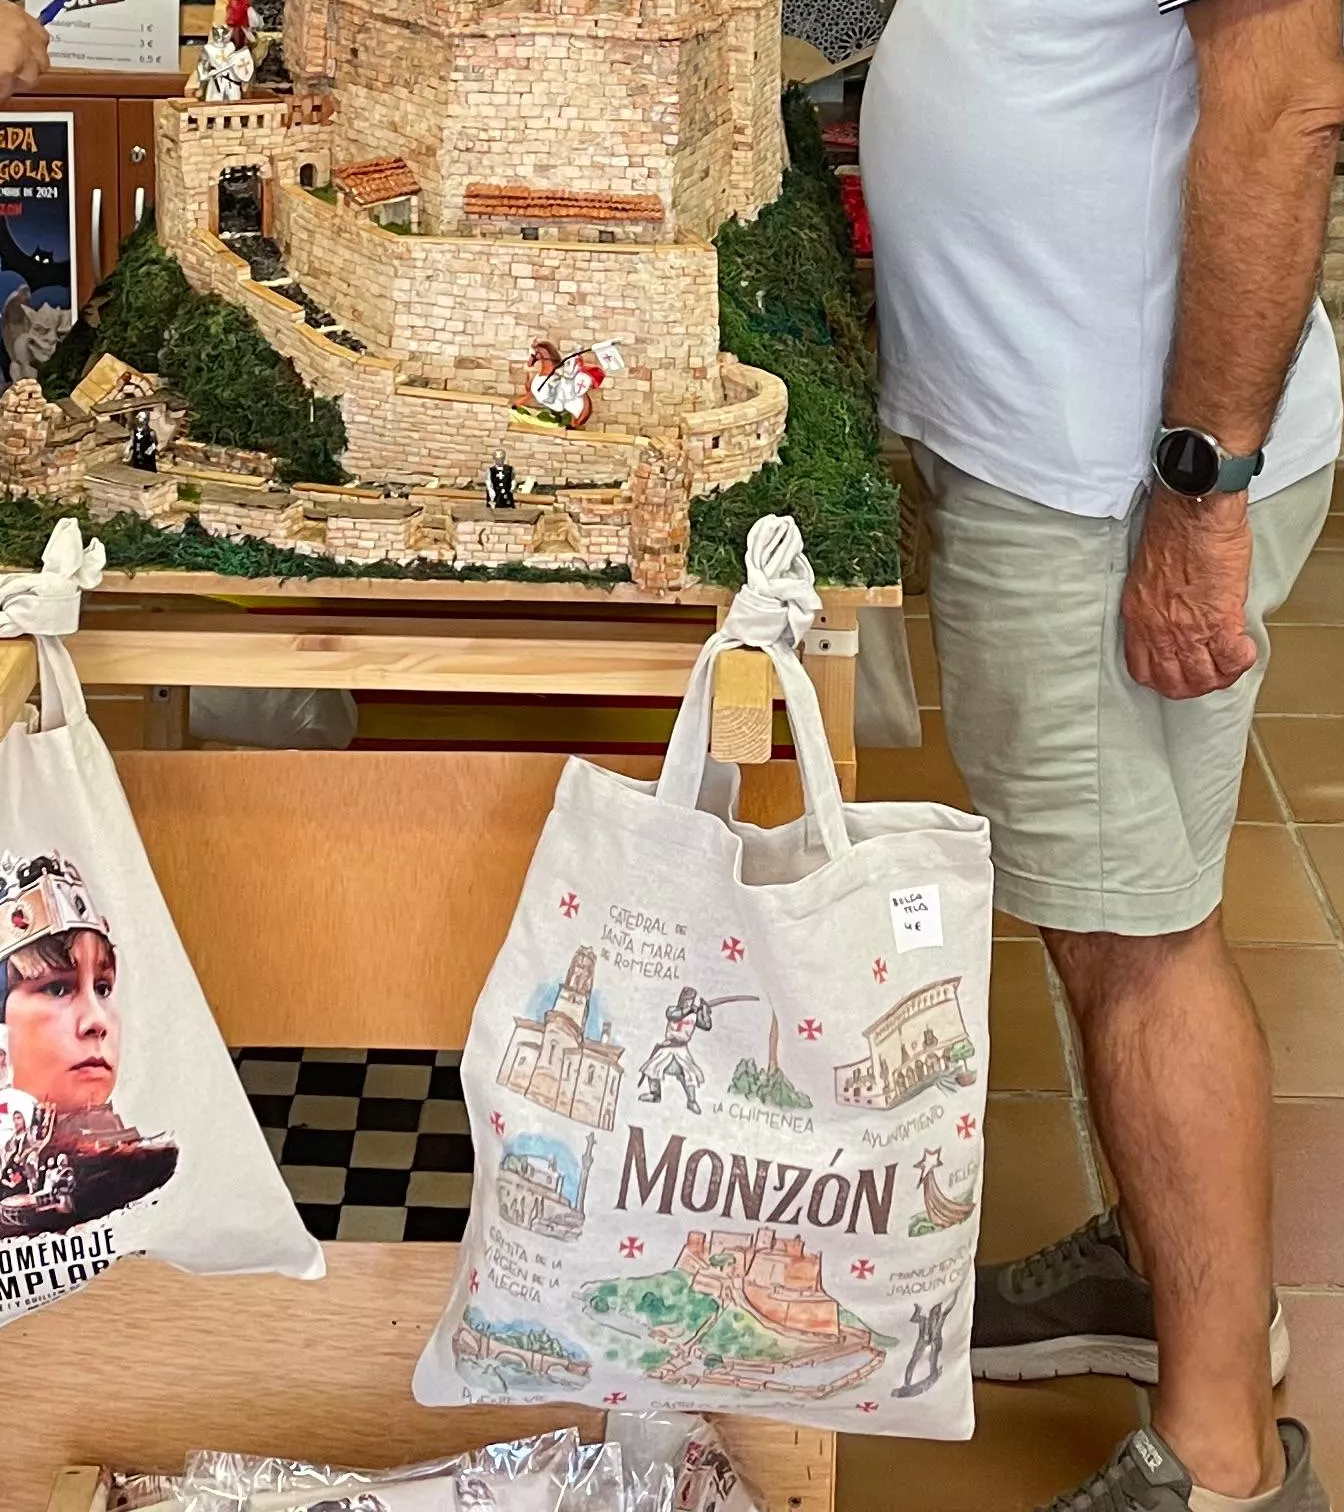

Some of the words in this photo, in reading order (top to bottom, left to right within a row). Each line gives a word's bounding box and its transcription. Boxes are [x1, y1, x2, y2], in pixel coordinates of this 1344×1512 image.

[36, 186, 58, 199] 2024
[609, 904, 668, 936] CATEDRAL
[675, 923, 688, 935] DE
[601, 923, 634, 954] SANTA
[614, 952, 680, 981] ROMERAL
[712, 1103, 724, 1114] LA
[729, 1103, 815, 1134] CHIMENEA
[861, 1104, 945, 1148] AYUNTAMIENTO
[613, 1124, 900, 1235] MONZÓN
[489, 1226, 528, 1263] ERMITA
[535, 1254, 547, 1266] DE
[551, 1260, 562, 1269] LA
[484, 1240, 529, 1281] VIRGEN
[532, 1273, 544, 1285] DE
[549, 1278, 560, 1289] LA
